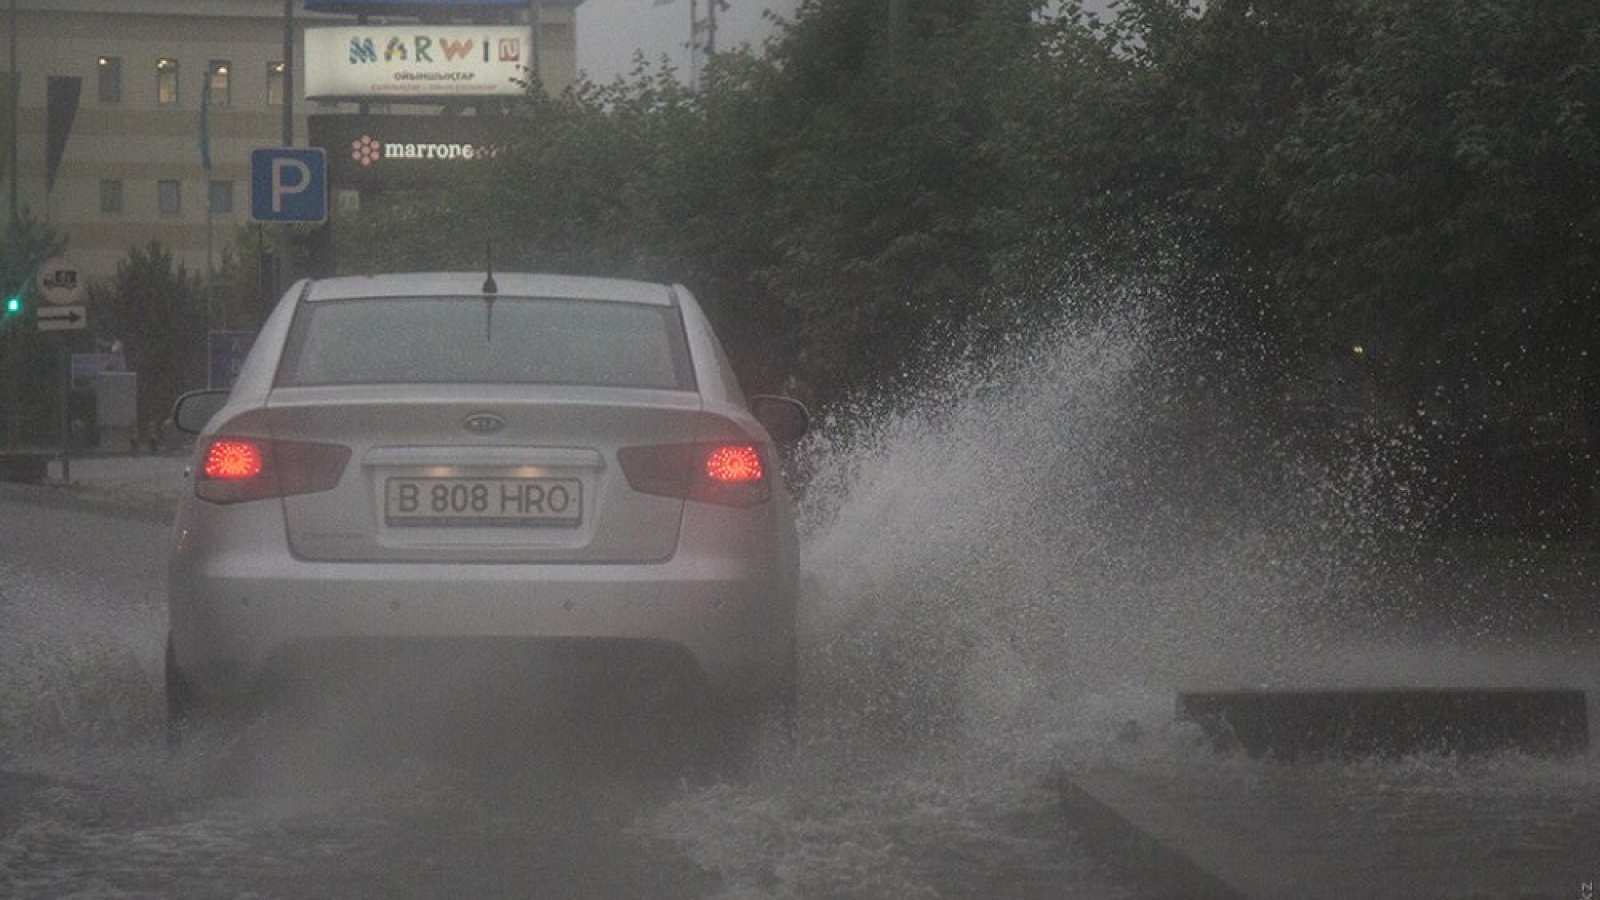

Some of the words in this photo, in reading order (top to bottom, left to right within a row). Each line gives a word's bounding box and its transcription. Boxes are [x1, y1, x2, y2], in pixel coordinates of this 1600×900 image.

[384, 143, 474, 159] marrone
[272, 158, 311, 213] P
[400, 484, 419, 512] B
[431, 484, 489, 513] 808
[500, 484, 569, 513] HRO
